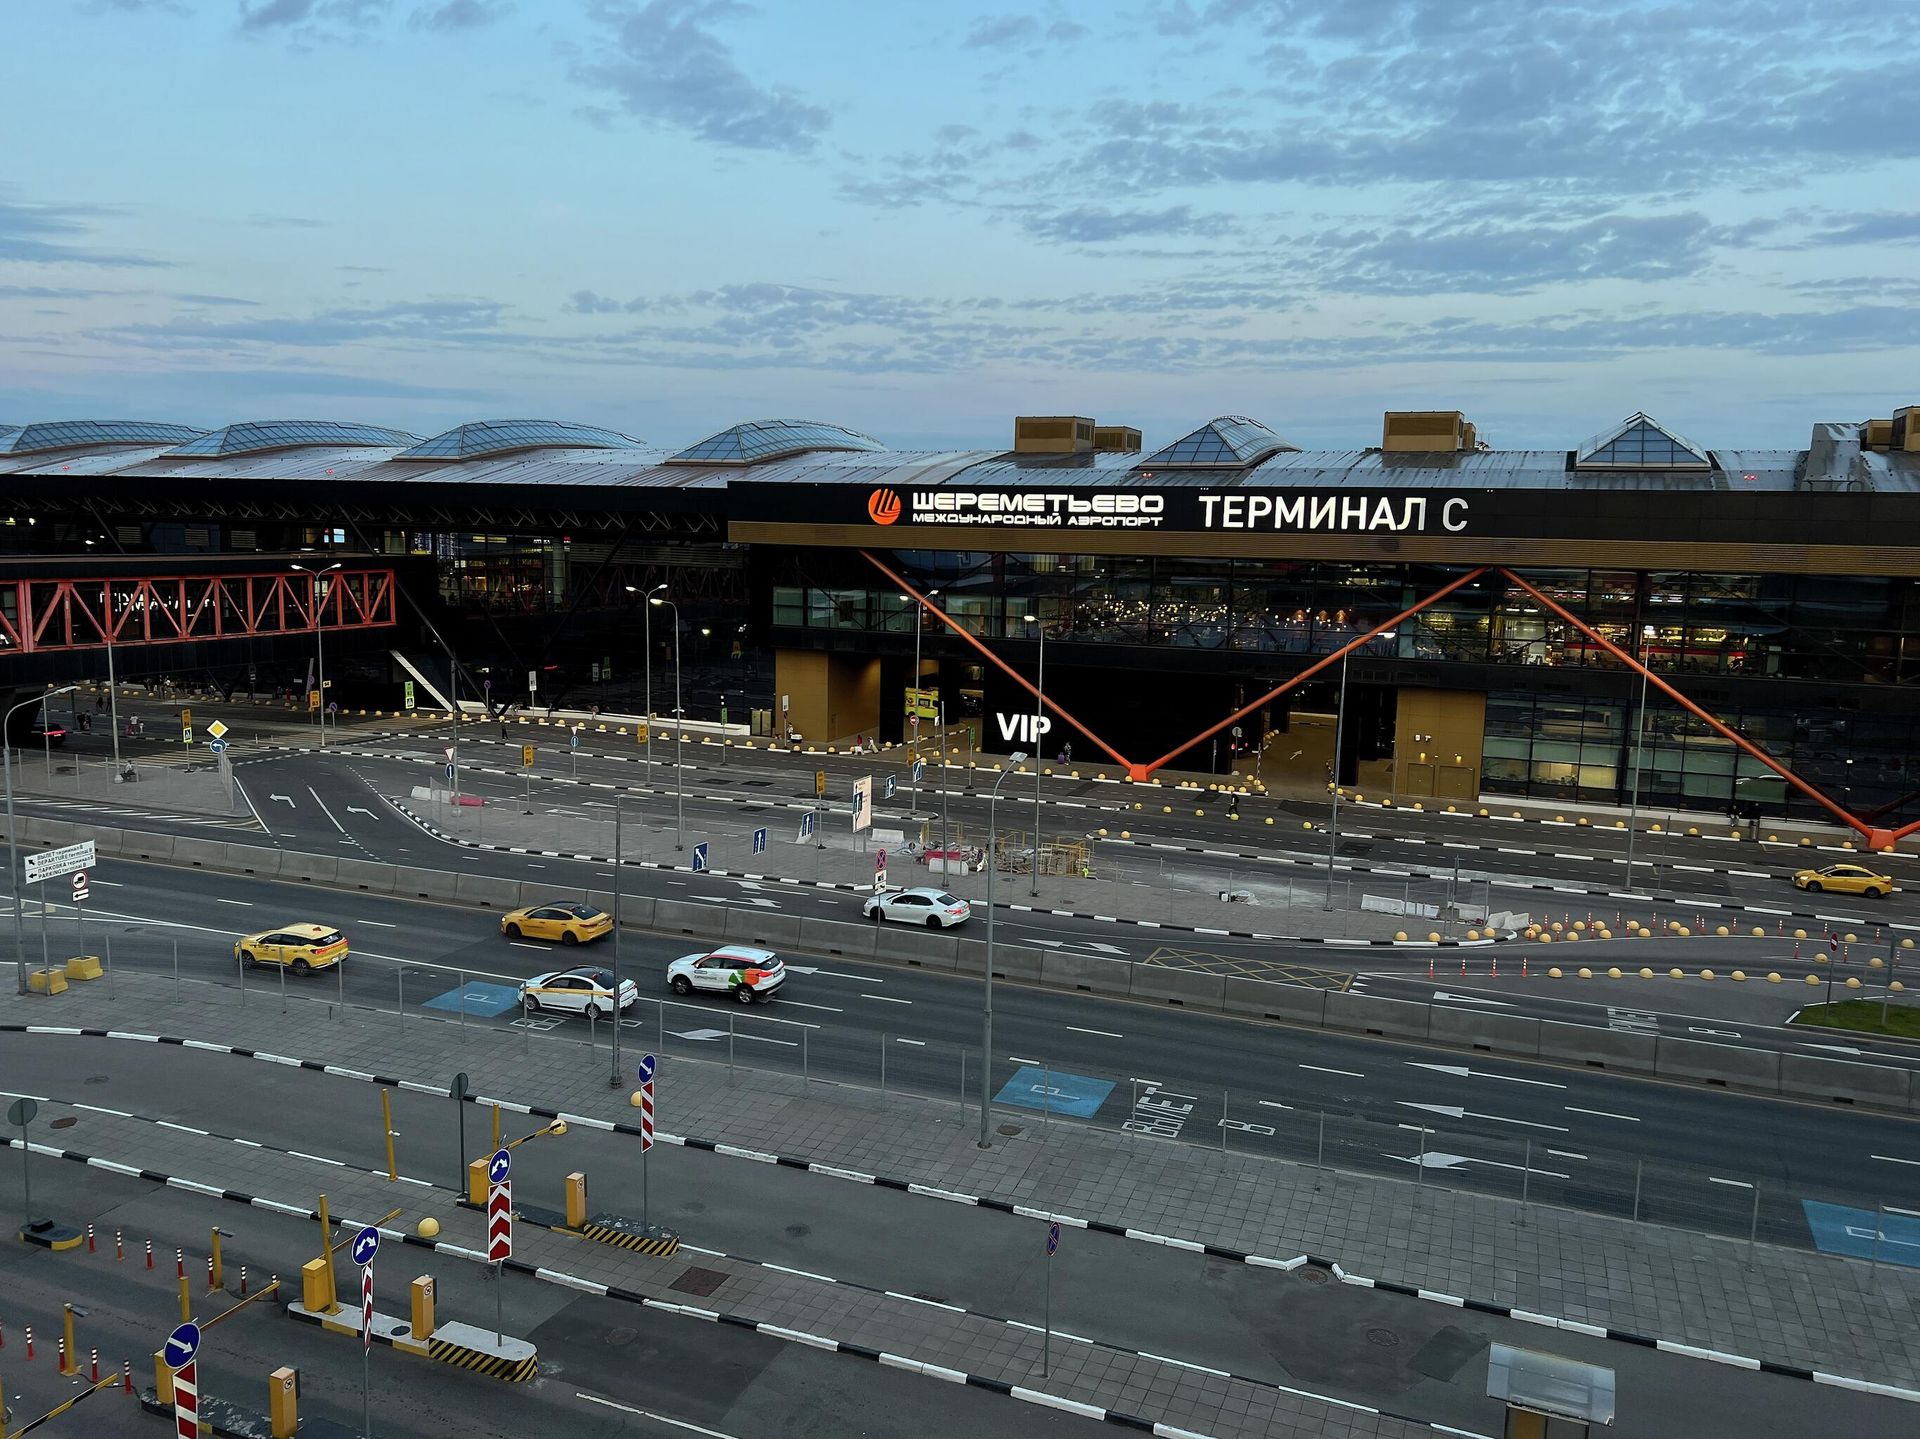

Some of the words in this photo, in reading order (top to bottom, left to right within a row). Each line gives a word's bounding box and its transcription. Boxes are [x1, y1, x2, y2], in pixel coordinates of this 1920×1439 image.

[912, 492, 1164, 513] ШЕРЕМЕТЬЕВО
[912, 512, 1062, 526] МЕЖДУНАРОДНЫЙ
[1067, 516, 1163, 527] АЭРОПОРТ
[1199, 495, 1427, 531] ТЕРМИНАЛ
[996, 712, 1051, 743] VIP
[37, 855, 68, 866] DEPARTURE
[38, 862, 67, 874] ПАРКОВКА
[38, 869, 62, 879] PARKING
